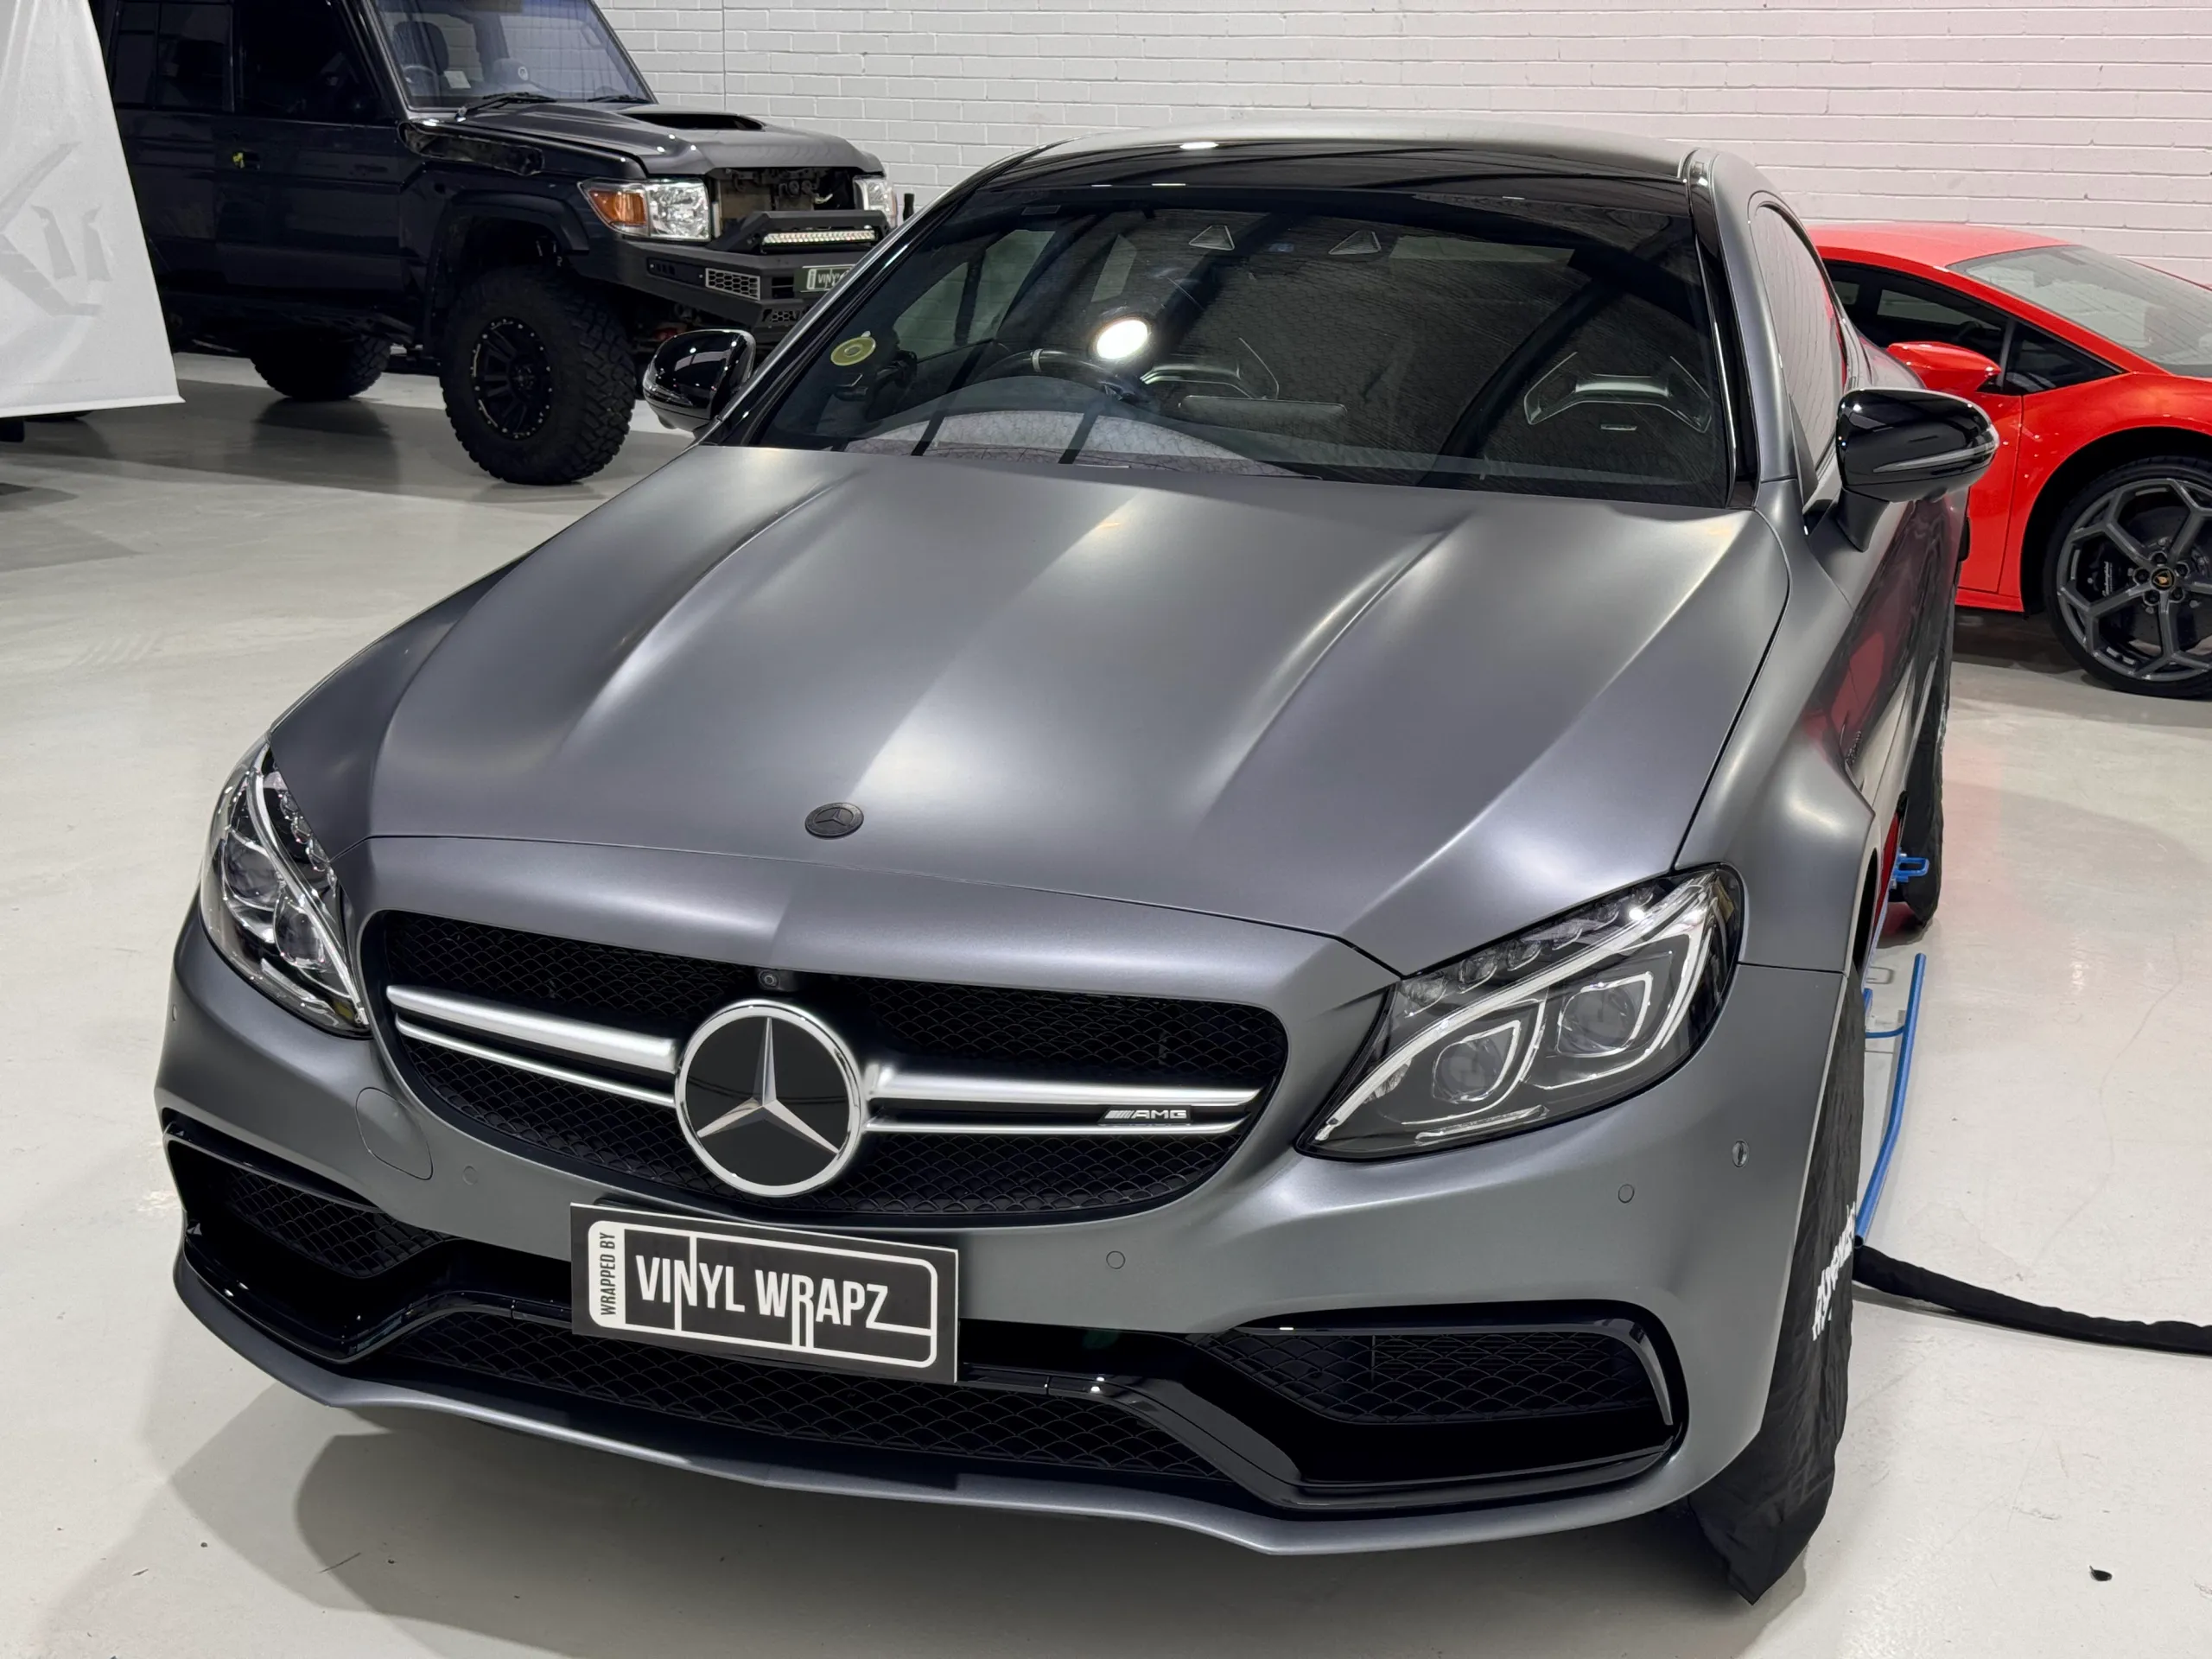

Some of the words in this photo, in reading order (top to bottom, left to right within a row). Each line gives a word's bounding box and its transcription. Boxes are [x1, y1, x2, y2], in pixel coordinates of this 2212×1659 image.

[1131, 1109, 1187, 1119] AMG
[599, 1232, 615, 1249] BY
[600, 1254, 616, 1315] WRAPPED
[635, 1255, 746, 1313] VINYL
[754, 1269, 889, 1329] WRAPZ
